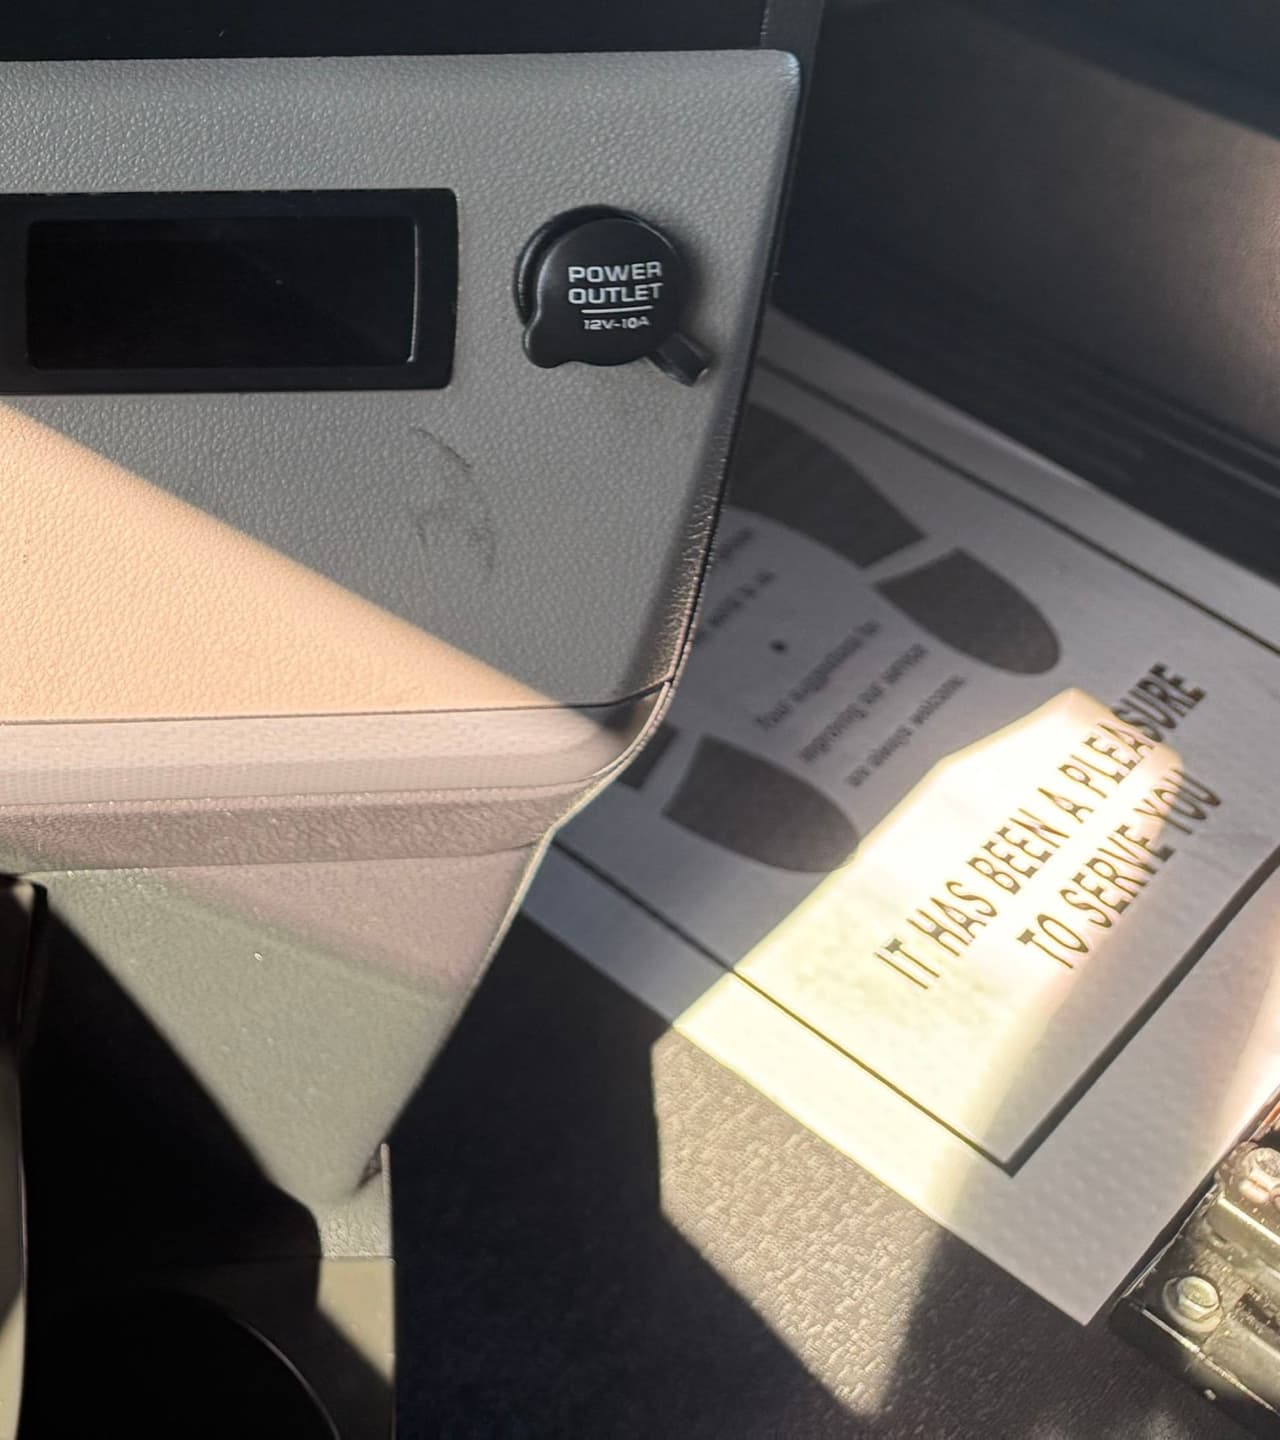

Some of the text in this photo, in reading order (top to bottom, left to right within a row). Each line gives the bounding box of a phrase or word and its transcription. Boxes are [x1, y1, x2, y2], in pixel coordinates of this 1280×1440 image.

[567, 261, 663, 283] POWER
[568, 282, 664, 305] OUTLET
[583, 315, 652, 330] 12V-10A
[875, 662, 1207, 989] IT HAS BEEN A PLEASURE
[1016, 768, 1222, 970] TO SERVE YOU
